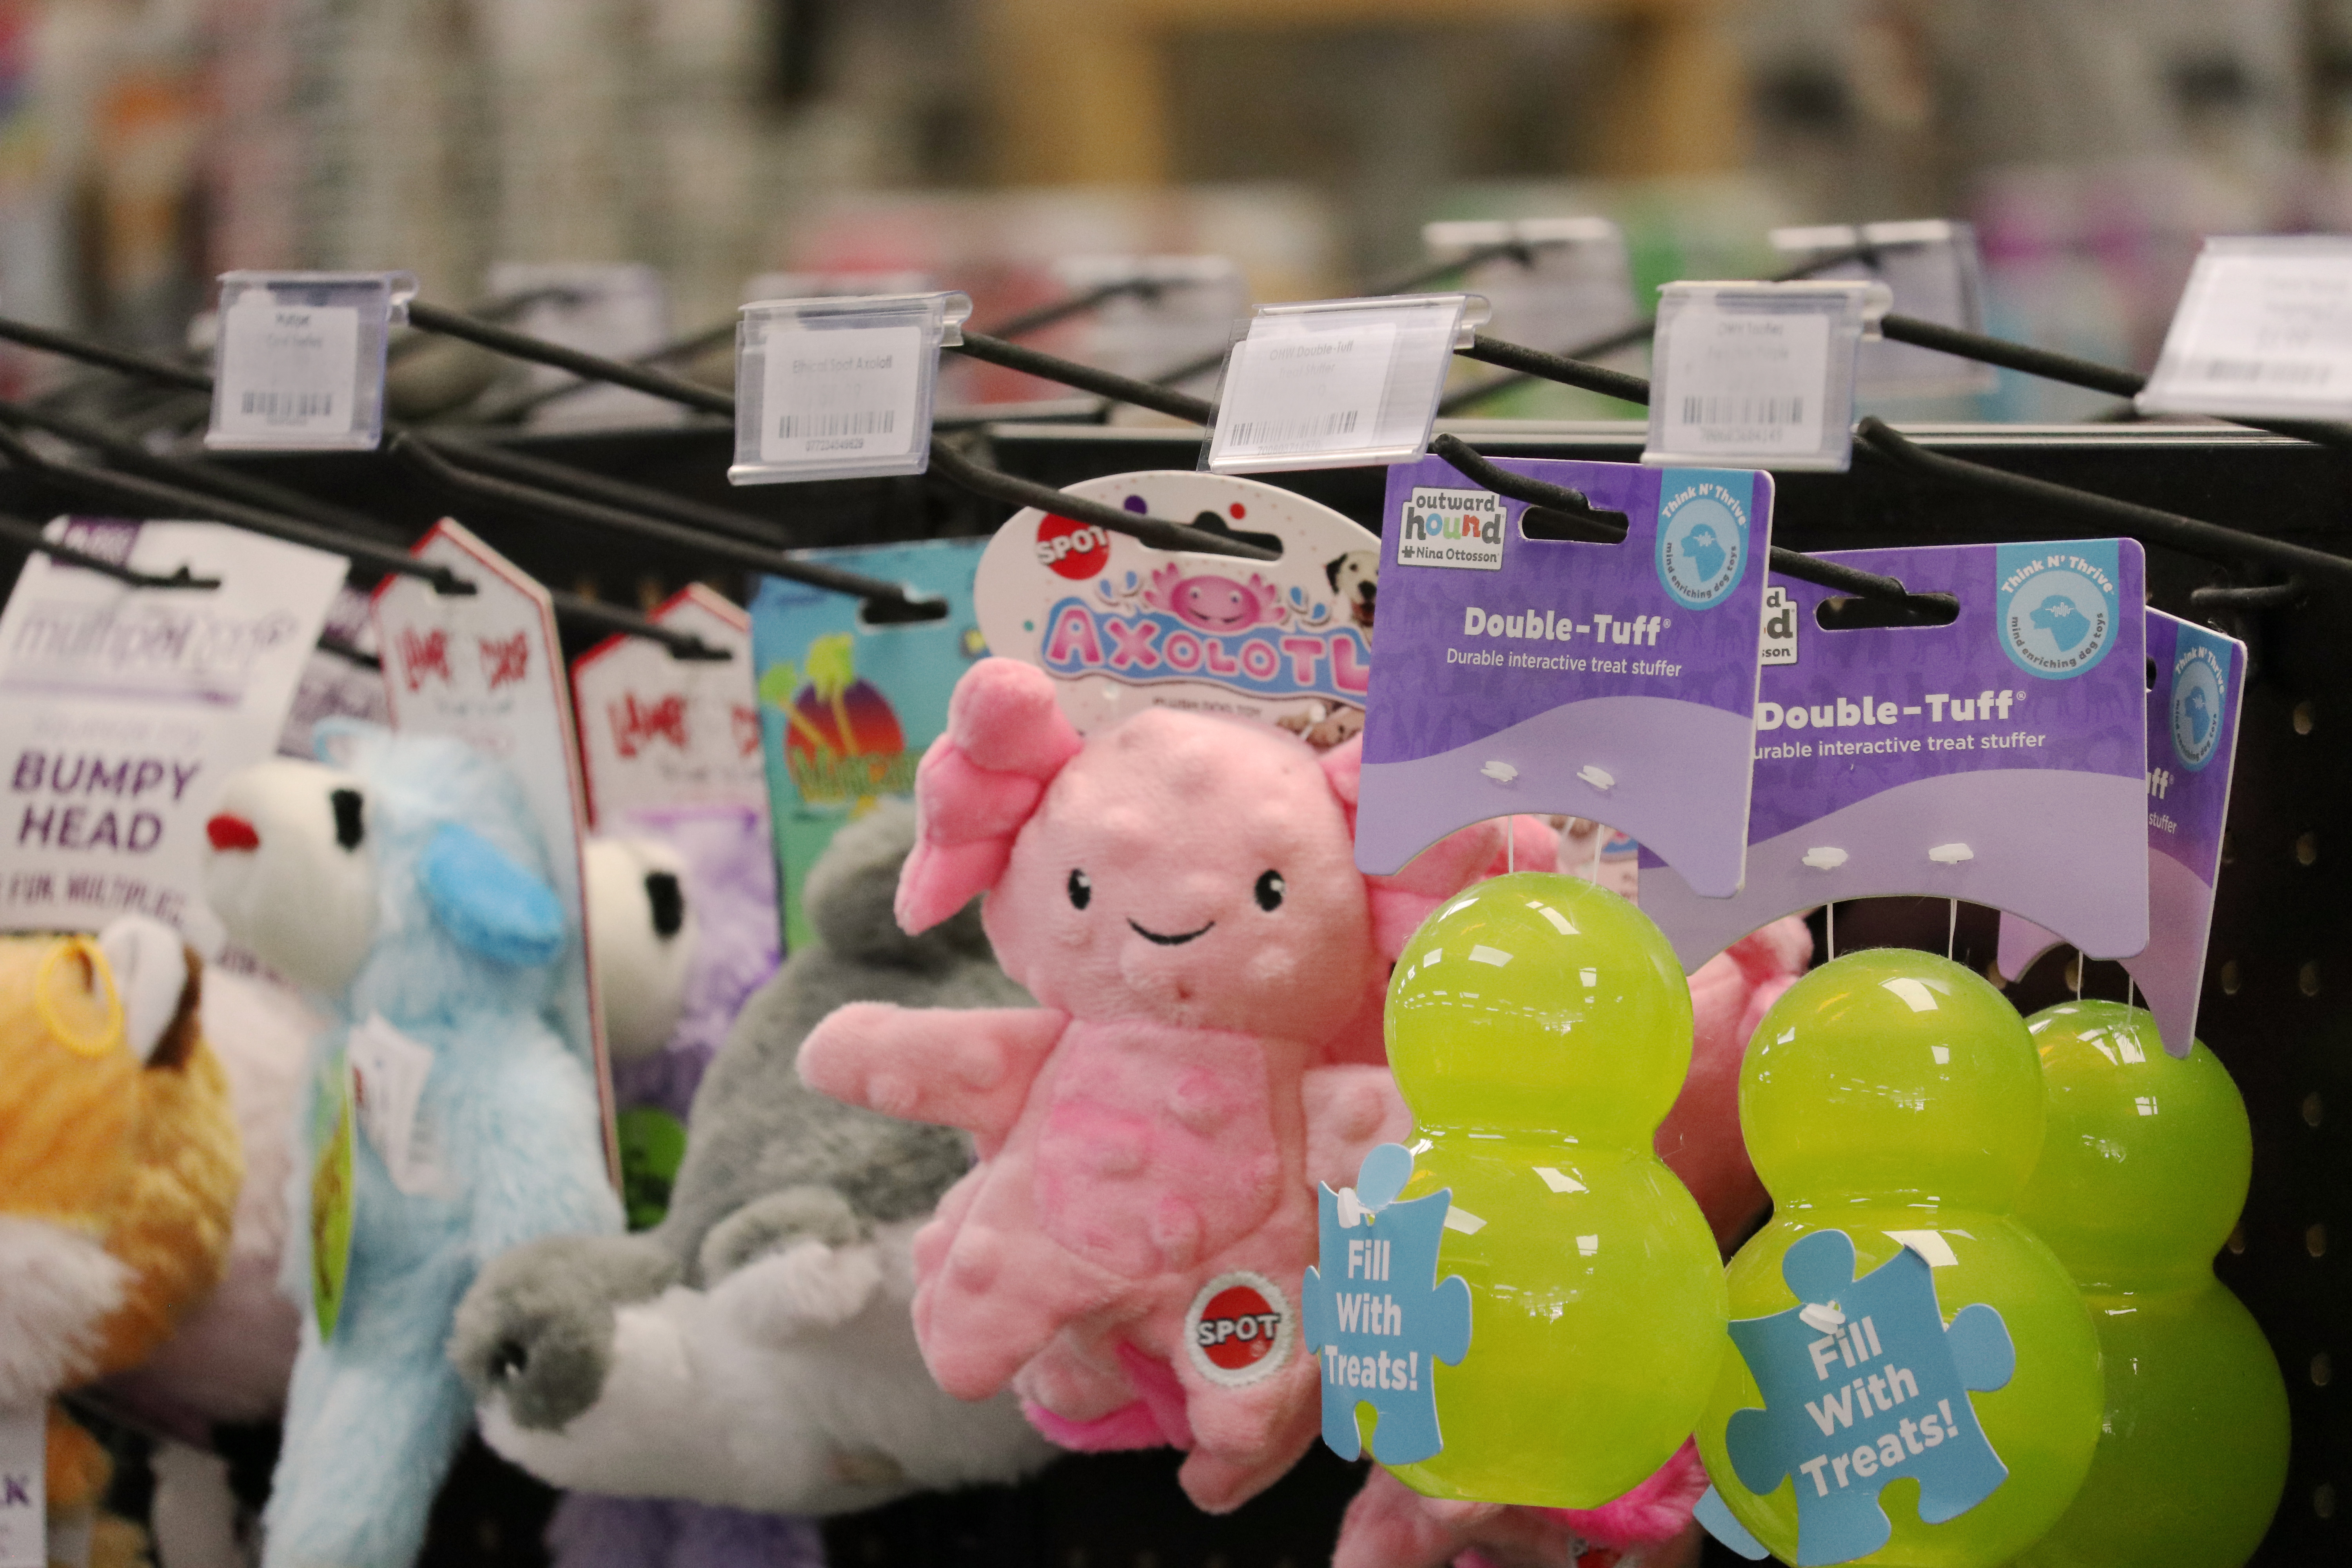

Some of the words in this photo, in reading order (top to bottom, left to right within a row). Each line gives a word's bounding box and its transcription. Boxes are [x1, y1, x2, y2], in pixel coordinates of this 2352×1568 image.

[793, 359, 827, 374] Ethical
[830, 358, 853, 373] Spot
[1416, 492, 1495, 512] outward
[1662, 486, 1696, 517] Think
[1699, 483, 1713, 495] N'
[1715, 485, 1746, 525] Thrive
[1036, 525, 1107, 566] SPOT
[1405, 507, 1501, 544] hound
[1417, 547, 1443, 559] Nina
[1446, 548, 1497, 562] Ottosson
[1672, 575, 1712, 598] enriching
[1714, 574, 1729, 592] dog
[1727, 546, 1737, 570] toys
[2001, 560, 2044, 593] Think
[2047, 555, 2065, 567] N'
[2069, 556, 2113, 593] Thrive
[1047, 608, 1370, 693] AXOLOTL
[2012, 617, 2025, 647] mind
[2022, 648, 2076, 668] enriching
[2079, 641, 2098, 659] dog
[2094, 613, 2105, 638] toys
[1447, 648, 1504, 666] Durable
[1508, 652, 1586, 671] interactive
[1591, 658, 1627, 674] treat
[1632, 659, 1682, 677] stuffer
[2176, 646, 2197, 674] Think
[2208, 651, 2225, 694] Thrive
[1754, 742, 1812, 760] urable
[1819, 737, 1921, 757] interactive
[1927, 735, 1975, 751] treat
[1981, 731, 2045, 749] stuffer
[13, 751, 201, 801] BUMPY
[18, 806, 162, 853] HEAD
[2149, 813, 2177, 834] stuffer
[1348, 1240, 1390, 1281] Fill
[1198, 1313, 1280, 1347] SPOT
[1336, 1292, 1401, 1336] With
[1325, 1345, 1418, 1390] Treats!
[1808, 1316, 1882, 1381] Fill
[1804, 1363, 1919, 1436] With
[1800, 1399, 1958, 1497] Treats!
